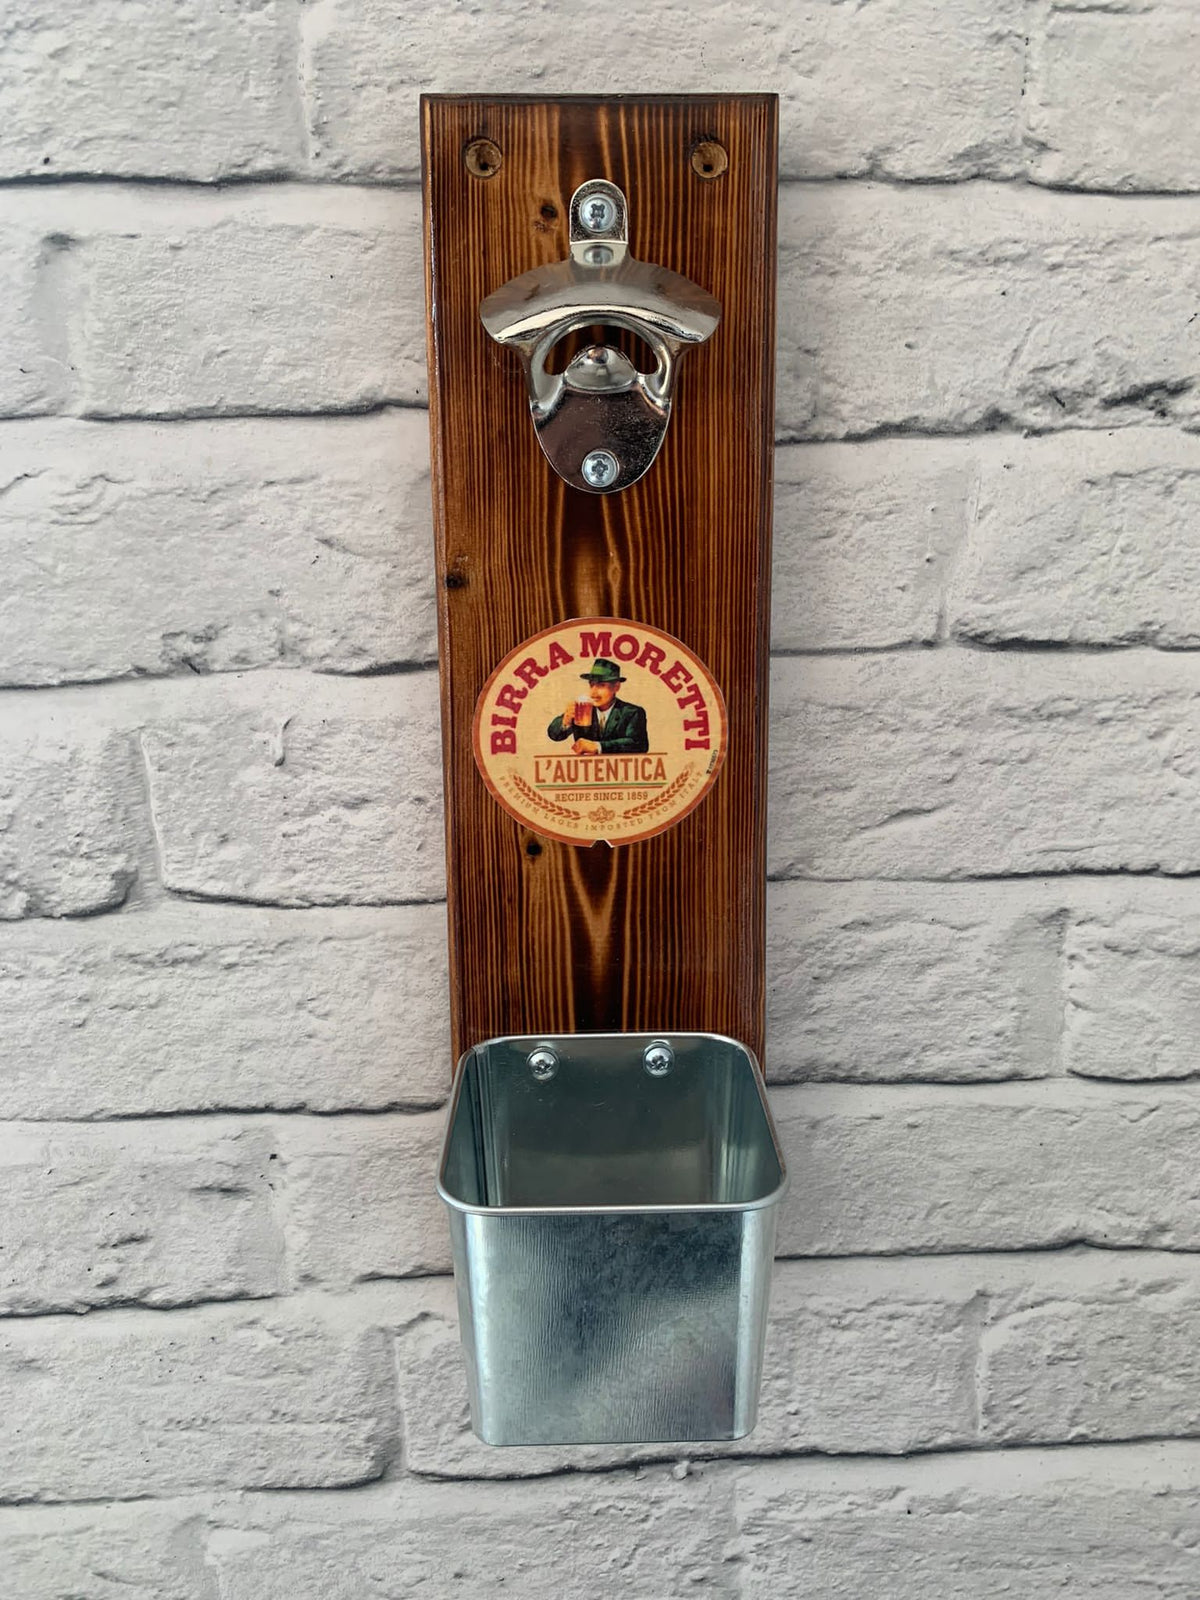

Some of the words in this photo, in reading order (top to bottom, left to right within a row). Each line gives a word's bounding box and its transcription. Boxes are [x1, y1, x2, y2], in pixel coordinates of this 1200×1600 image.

[490, 641, 574, 755] BIRRA
[579, 631, 711, 751] MORETTI
[534, 757, 668, 784] L'AUTENTICA
[555, 792, 591, 802] RECIPE
[593, 791, 624, 801] SINCE
[626, 791, 649, 801] 1859
